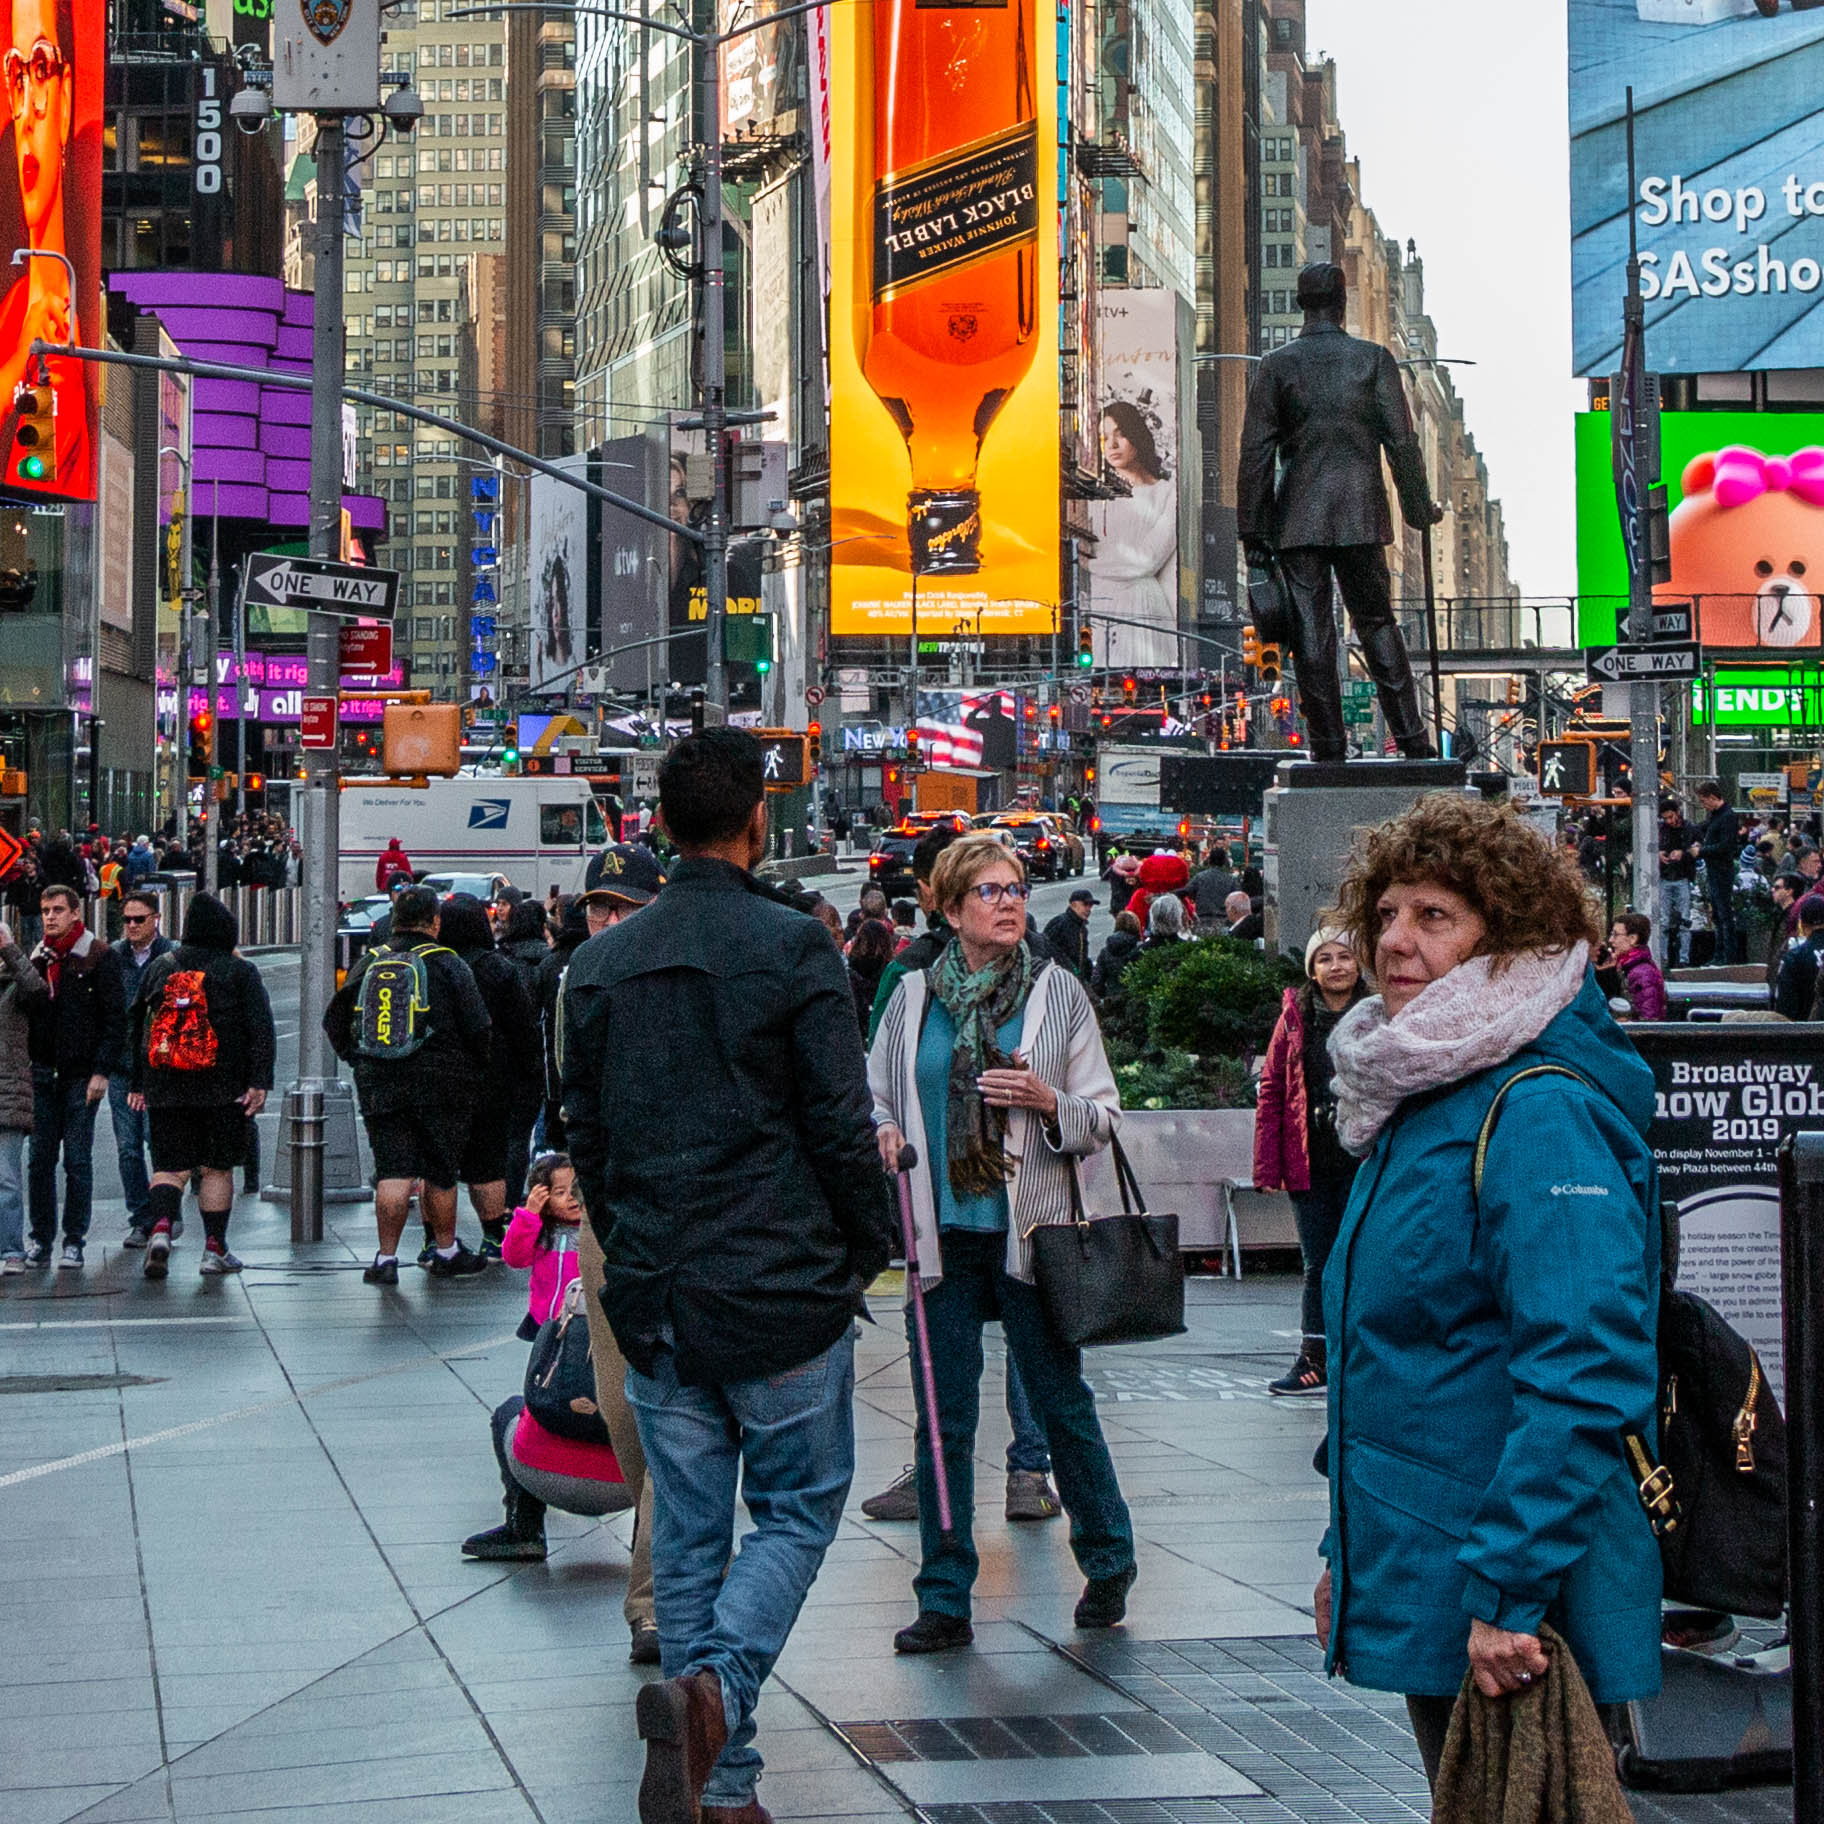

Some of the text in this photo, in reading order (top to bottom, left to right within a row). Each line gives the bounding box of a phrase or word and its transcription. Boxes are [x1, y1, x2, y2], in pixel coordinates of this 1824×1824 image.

[1639, 178, 1767, 233] Shop
[885, 183, 1035, 254] BLACK LABEL
[918, 211, 1018, 259] JOHNNIE WALKER
[270, 572, 378, 603] ONE WAY
[1659, 614, 1683, 630] WAY
[350, 630, 379, 641] STANDING
[268, 663, 282, 680] it
[1603, 653, 1687, 672] ONE WAY
[378, 986, 392, 1046] OAKLEY
[1671, 1059, 1813, 1087] Broadway
[1712, 1119, 1780, 1141] 2019
[1654, 1148, 1754, 1159] On display November
[1683, 1162, 1778, 1174] Plaza between 44th
[1561, 1183, 1609, 1196] Columbia
